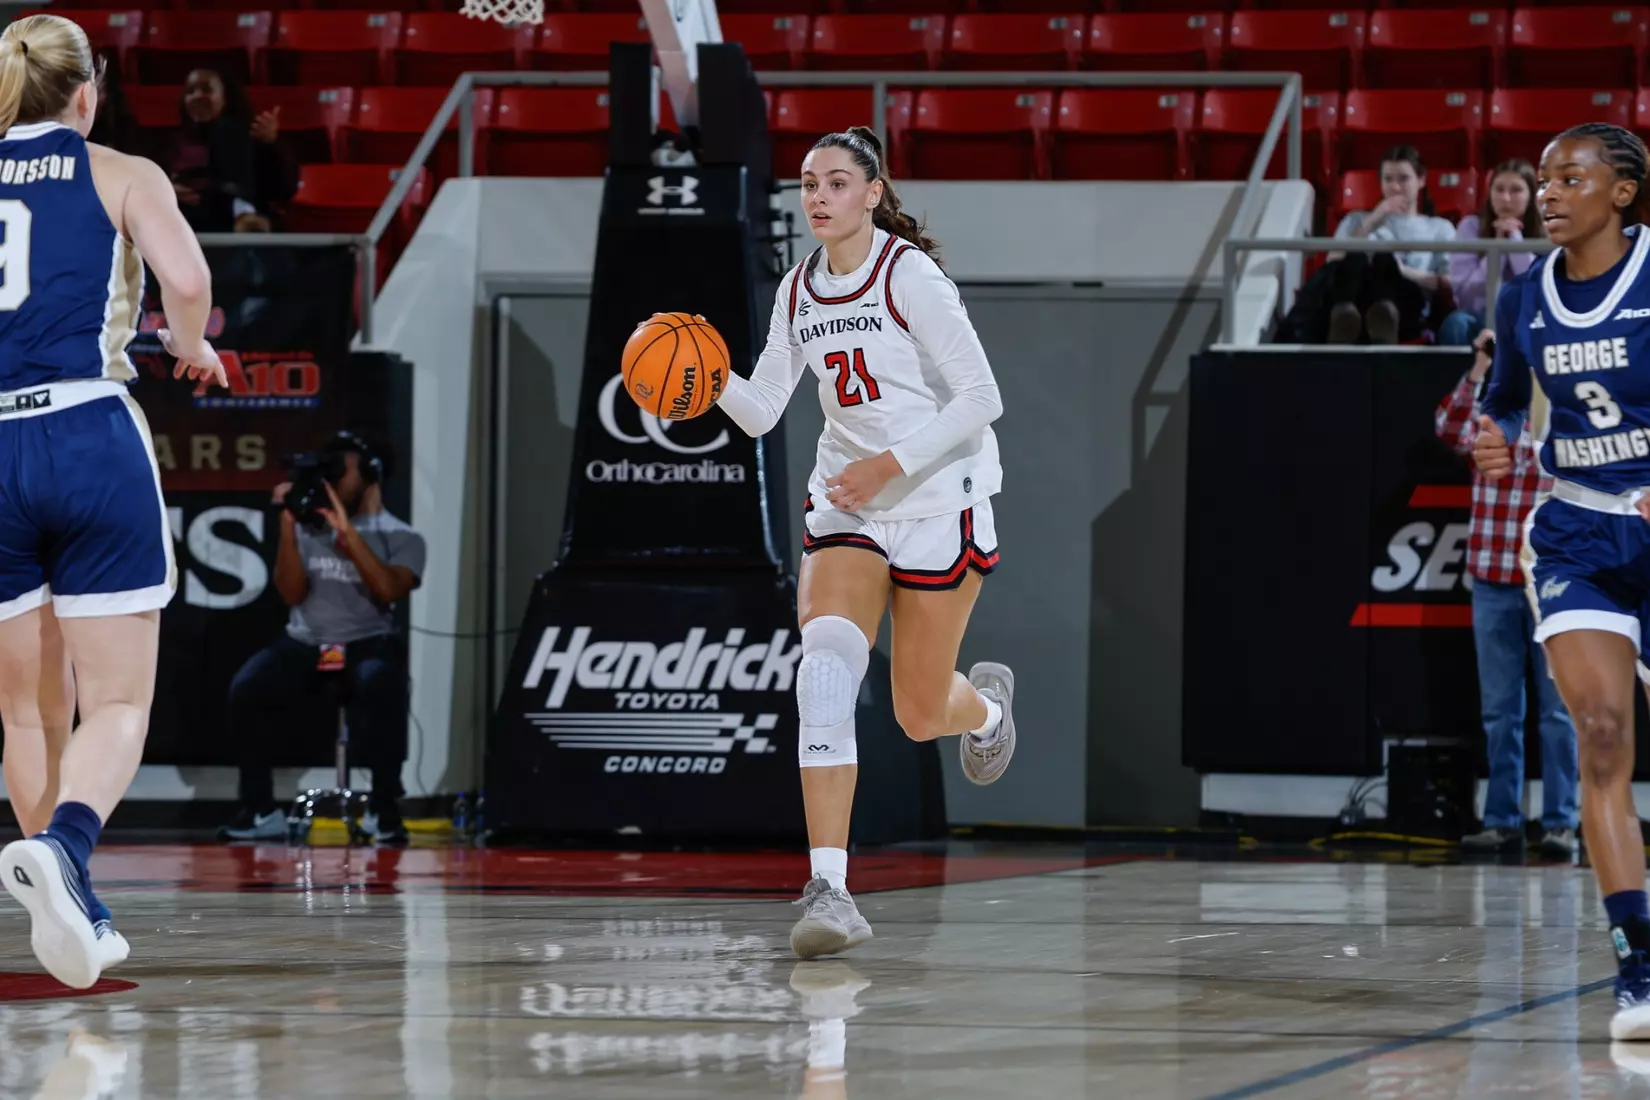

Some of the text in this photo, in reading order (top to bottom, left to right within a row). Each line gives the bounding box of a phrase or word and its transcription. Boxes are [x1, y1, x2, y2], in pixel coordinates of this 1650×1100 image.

[800, 316, 882, 344] DAVIDSON
[824, 347, 882, 408] 21
[1543, 337, 1630, 376] GEORGE
[667, 366, 696, 419] Wilson
[1573, 380, 1623, 430] 3
[1553, 427, 1650, 469] WASHING
[585, 458, 745, 485] OrthoCarolina
[1371, 521, 1473, 592] SE
[522, 626, 801, 708] Hendrick
[614, 692, 720, 710] TOYOTA
[604, 756, 727, 774] CONCORD
